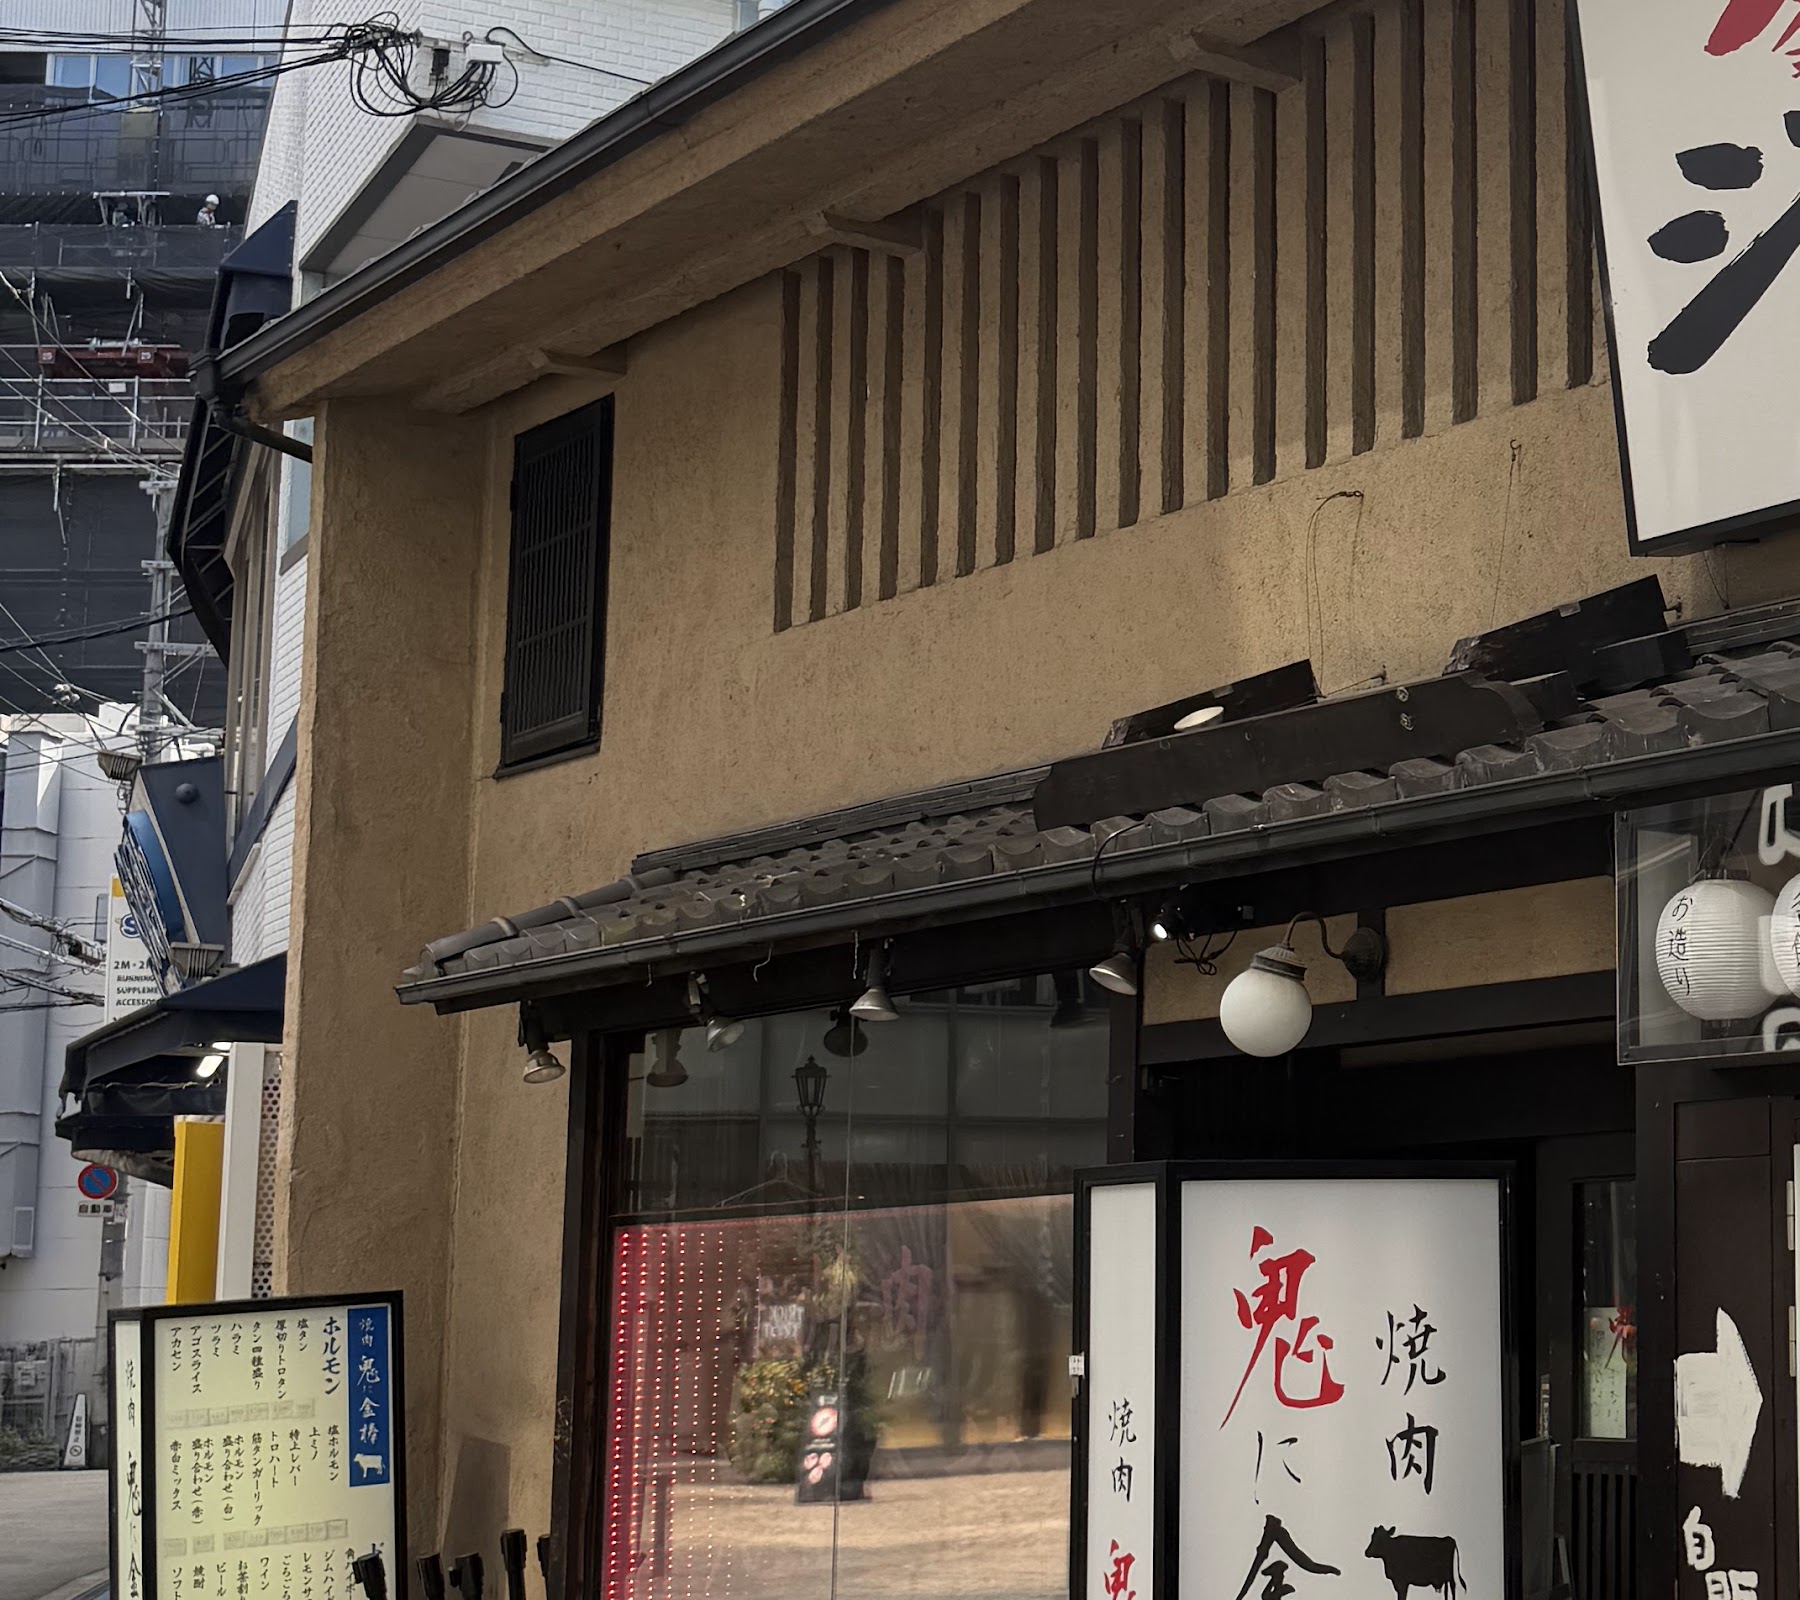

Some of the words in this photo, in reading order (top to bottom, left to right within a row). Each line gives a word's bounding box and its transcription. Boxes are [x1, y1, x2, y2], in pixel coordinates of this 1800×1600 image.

[1666, 893, 1700, 998] お造り
[171, 1327, 182, 1371] アカセン
[190, 1325, 202, 1393] アゴスライス
[211, 1324, 221, 1357] ツラミ
[231, 1323, 242, 1355] ハラミ
[252, 1321, 264, 1390] タン四種盛り
[275, 1319, 287, 1400] 厚切りトロタン
[297, 1318, 309, 1352] 塩タン
[323, 1316, 341, 1395] ホルモン
[359, 1318, 375, 1347] 焼肉
[357, 1355, 381, 1446] 鬼に金棒
[1373, 1303, 1447, 1497] 焼肉
[204, 1438, 214, 1483] ホルモン
[234, 1435, 245, 1480] ホルモン
[269, 1431, 280, 1488] トロハート
[289, 1429, 301, 1486] 特上レバー
[309, 1427, 321, 1461] 上ミノ
[328, 1425, 340, 1481] 塩ホルモン
[1106, 1396, 1140, 1503] 焼肉
[170, 1440, 182, 1511] 赤白ミックス
[193, 1565, 205, 1589] 焼酎
[216, 1563, 227, 1597] ビール
[260, 1557, 270, 1591] ワイン
